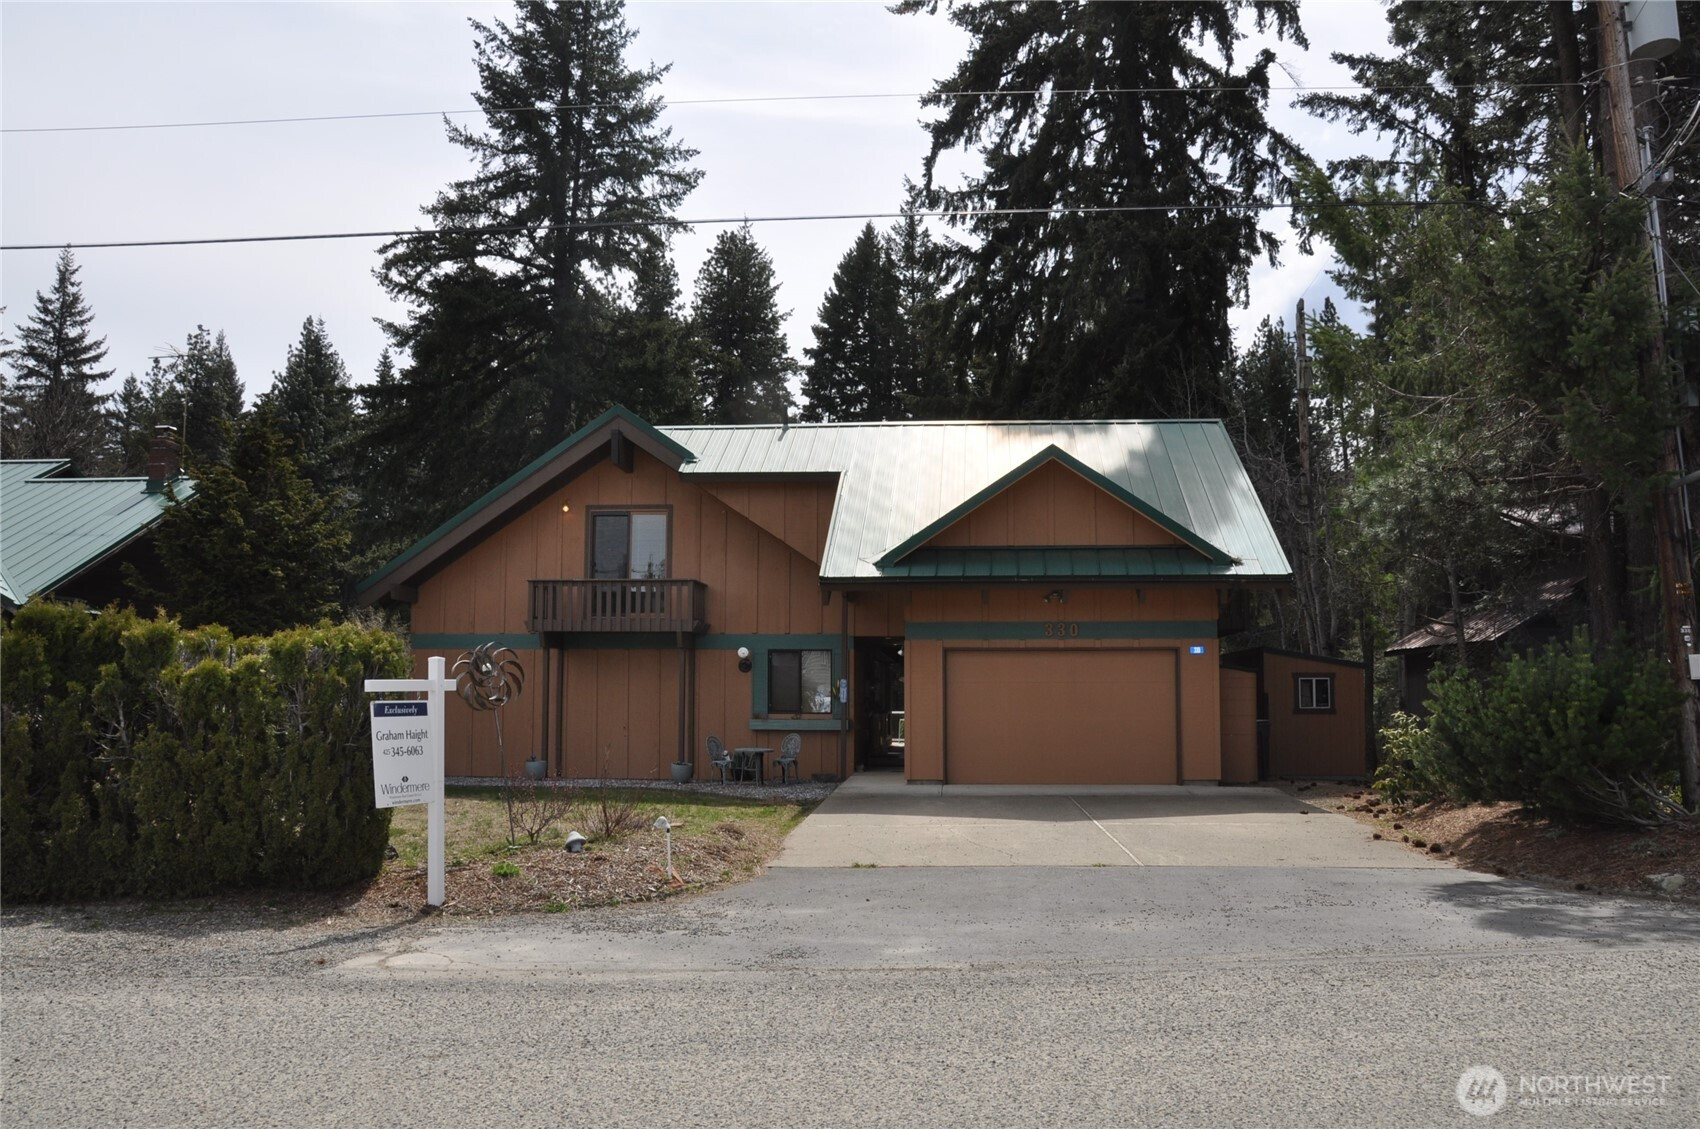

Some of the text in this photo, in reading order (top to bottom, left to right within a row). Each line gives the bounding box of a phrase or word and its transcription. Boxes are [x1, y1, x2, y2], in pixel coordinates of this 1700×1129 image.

[1045, 623, 1078, 636] 330
[384, 705, 418, 716] Exclusively
[376, 729, 428, 742] Graham Haight
[390, 745, 424, 757] 345-6063
[380, 783, 430, 795] Windermere
